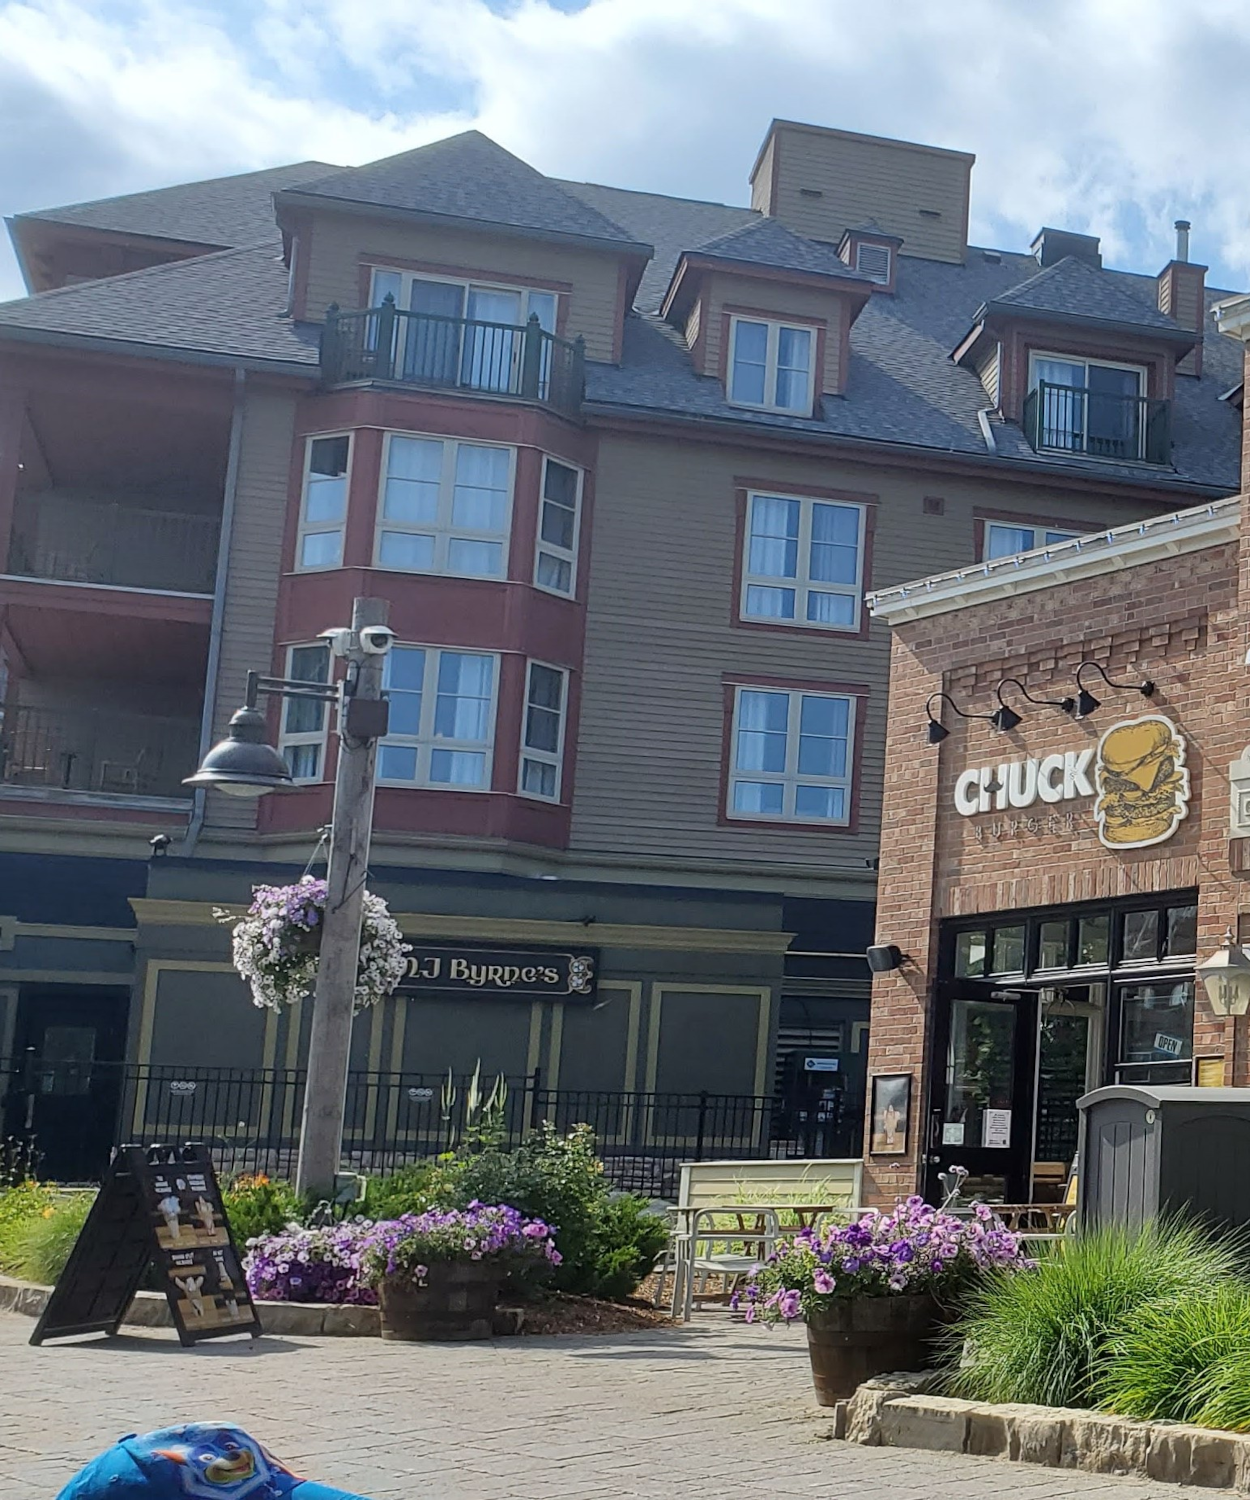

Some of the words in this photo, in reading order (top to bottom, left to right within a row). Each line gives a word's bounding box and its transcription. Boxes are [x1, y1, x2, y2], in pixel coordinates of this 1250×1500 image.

[954, 748, 1095, 816] CHUCK
[975, 812, 1075, 840] BURGER
[1159, 1036, 1178, 1053] OPEN
